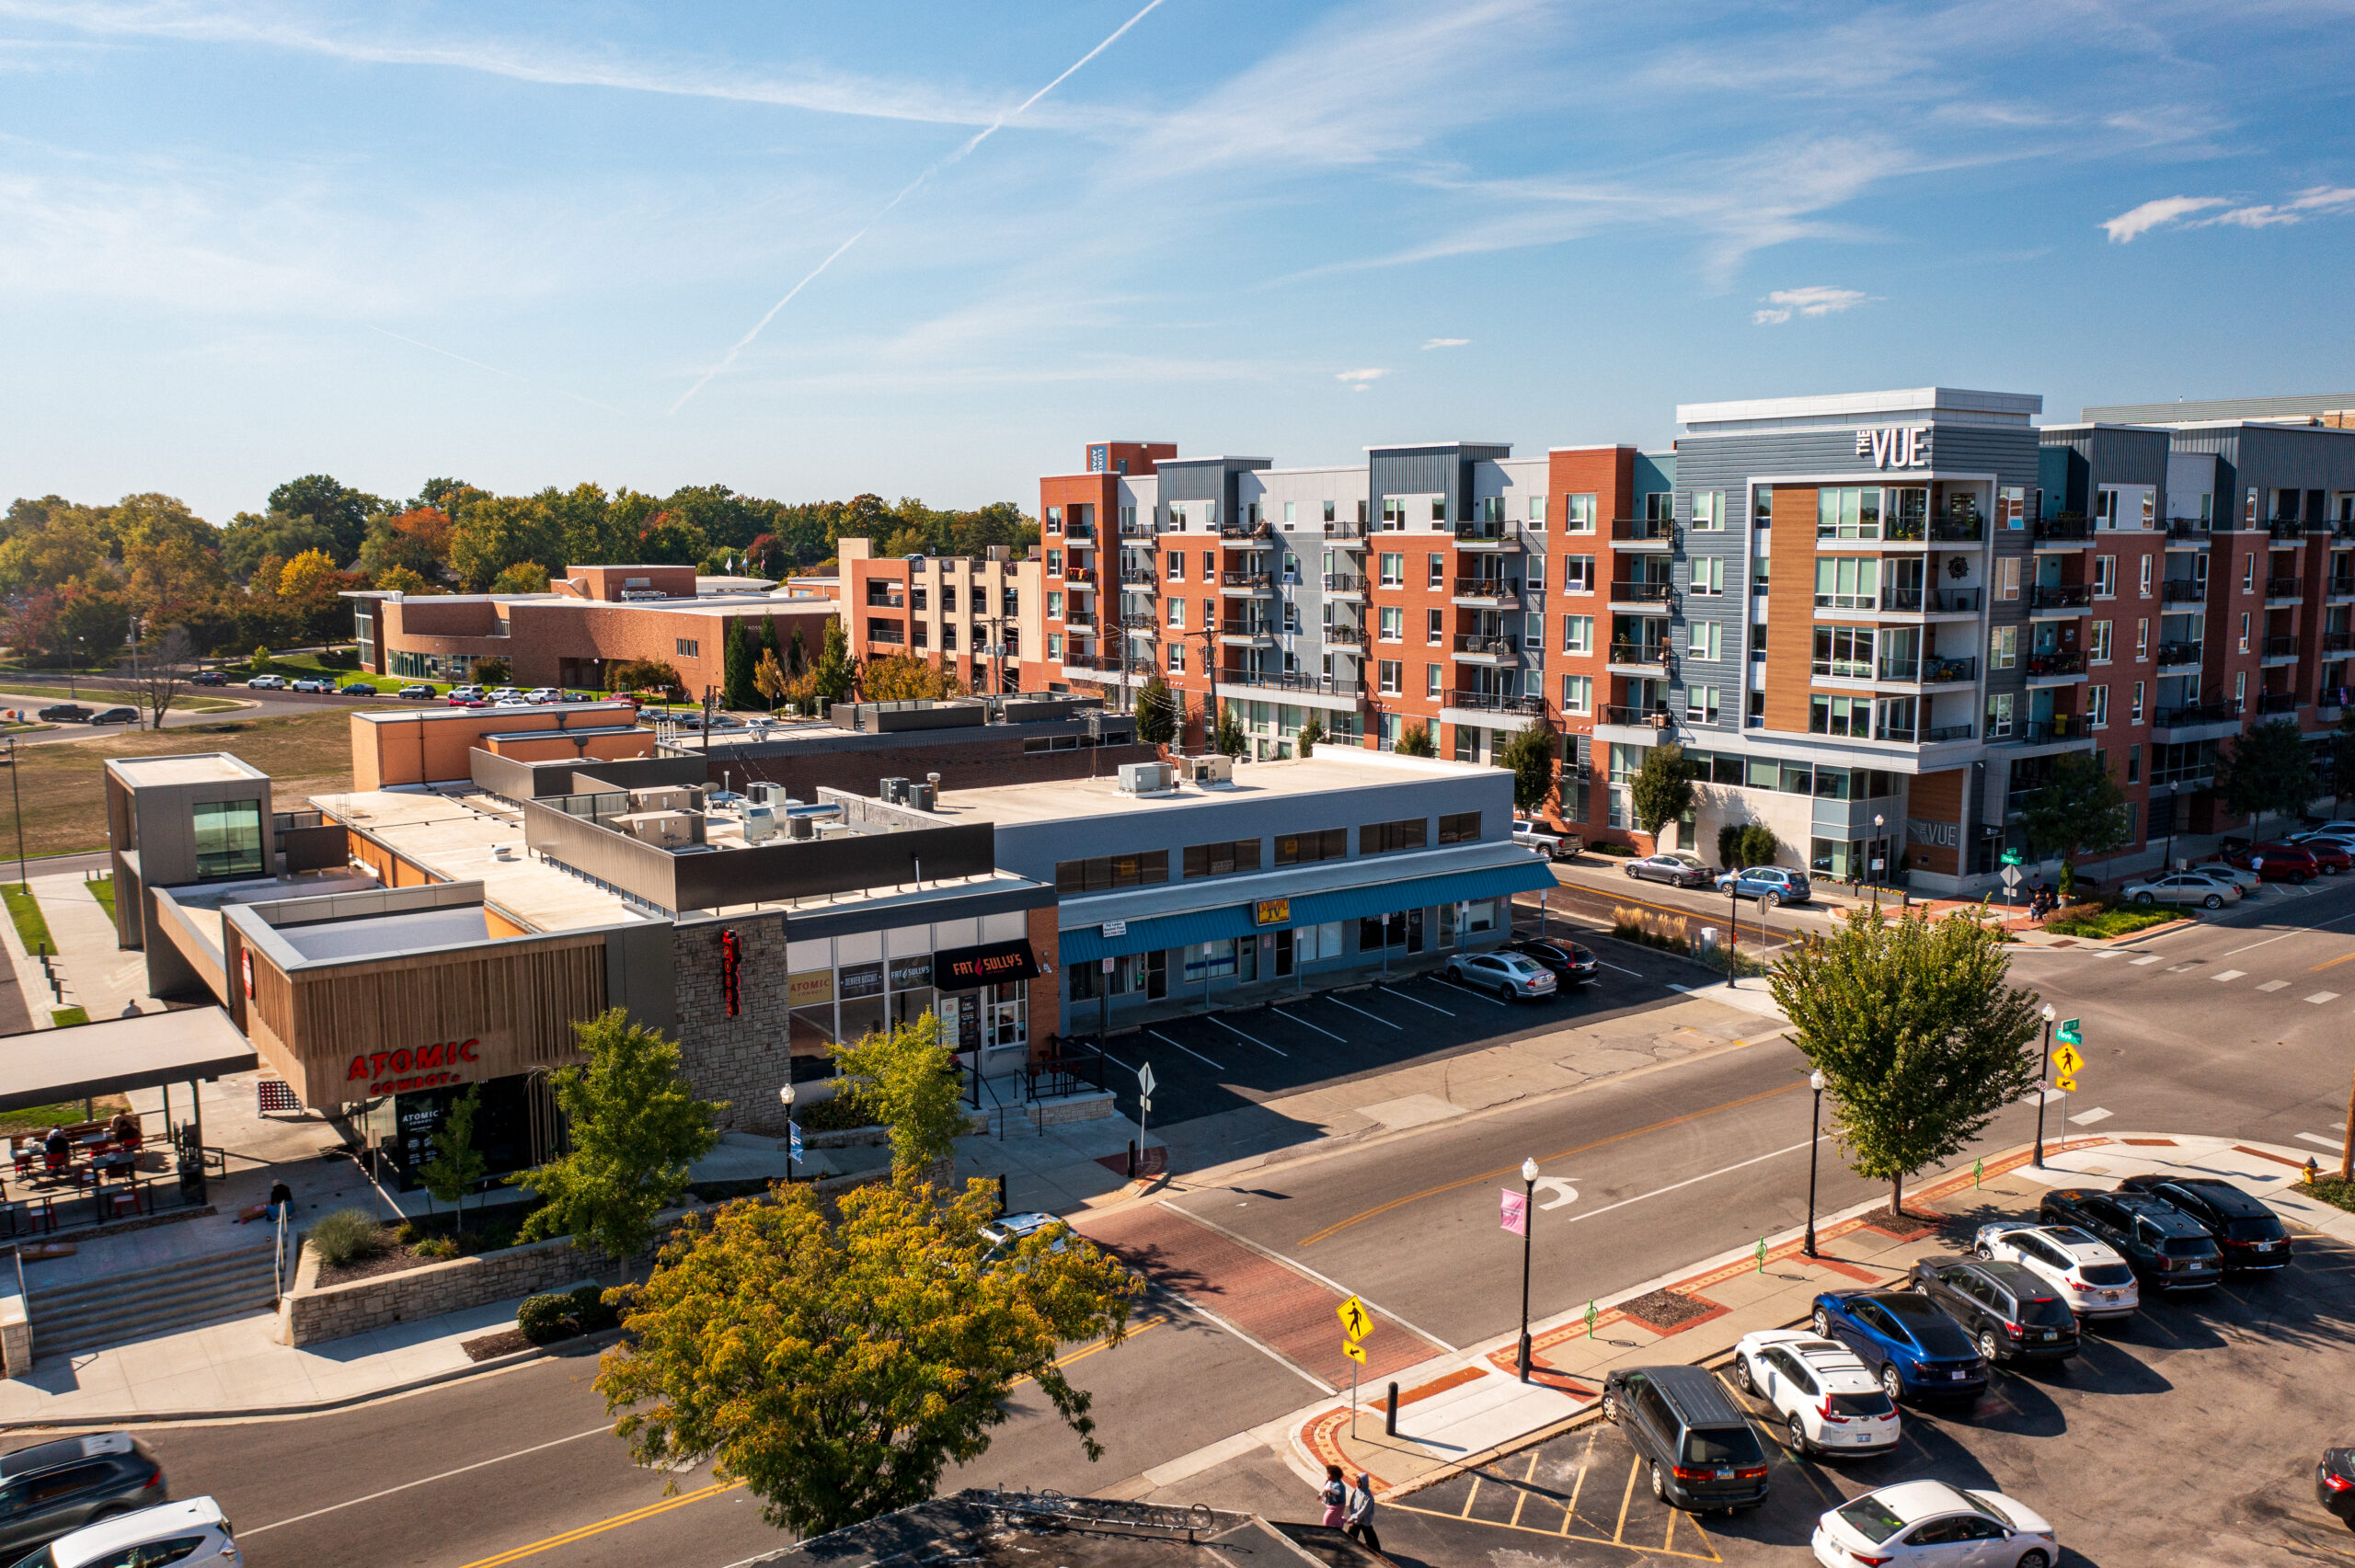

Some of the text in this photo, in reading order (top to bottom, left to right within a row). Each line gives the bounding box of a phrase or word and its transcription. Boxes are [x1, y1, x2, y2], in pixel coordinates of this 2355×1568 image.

[1855, 427, 1927, 468] THE VUE
[1928, 823, 1957, 846] VUE
[1267, 907, 1281, 919] TV
[890, 966, 930, 979] FAT SULLY'S
[952, 953, 1024, 976] FAT SULLY'S
[789, 978, 831, 993] ATOMIC
[347, 1038, 480, 1082] ATOMIC
[370, 1071, 451, 1096] COWBOY
[403, 1109, 440, 1123] ATOMIC
